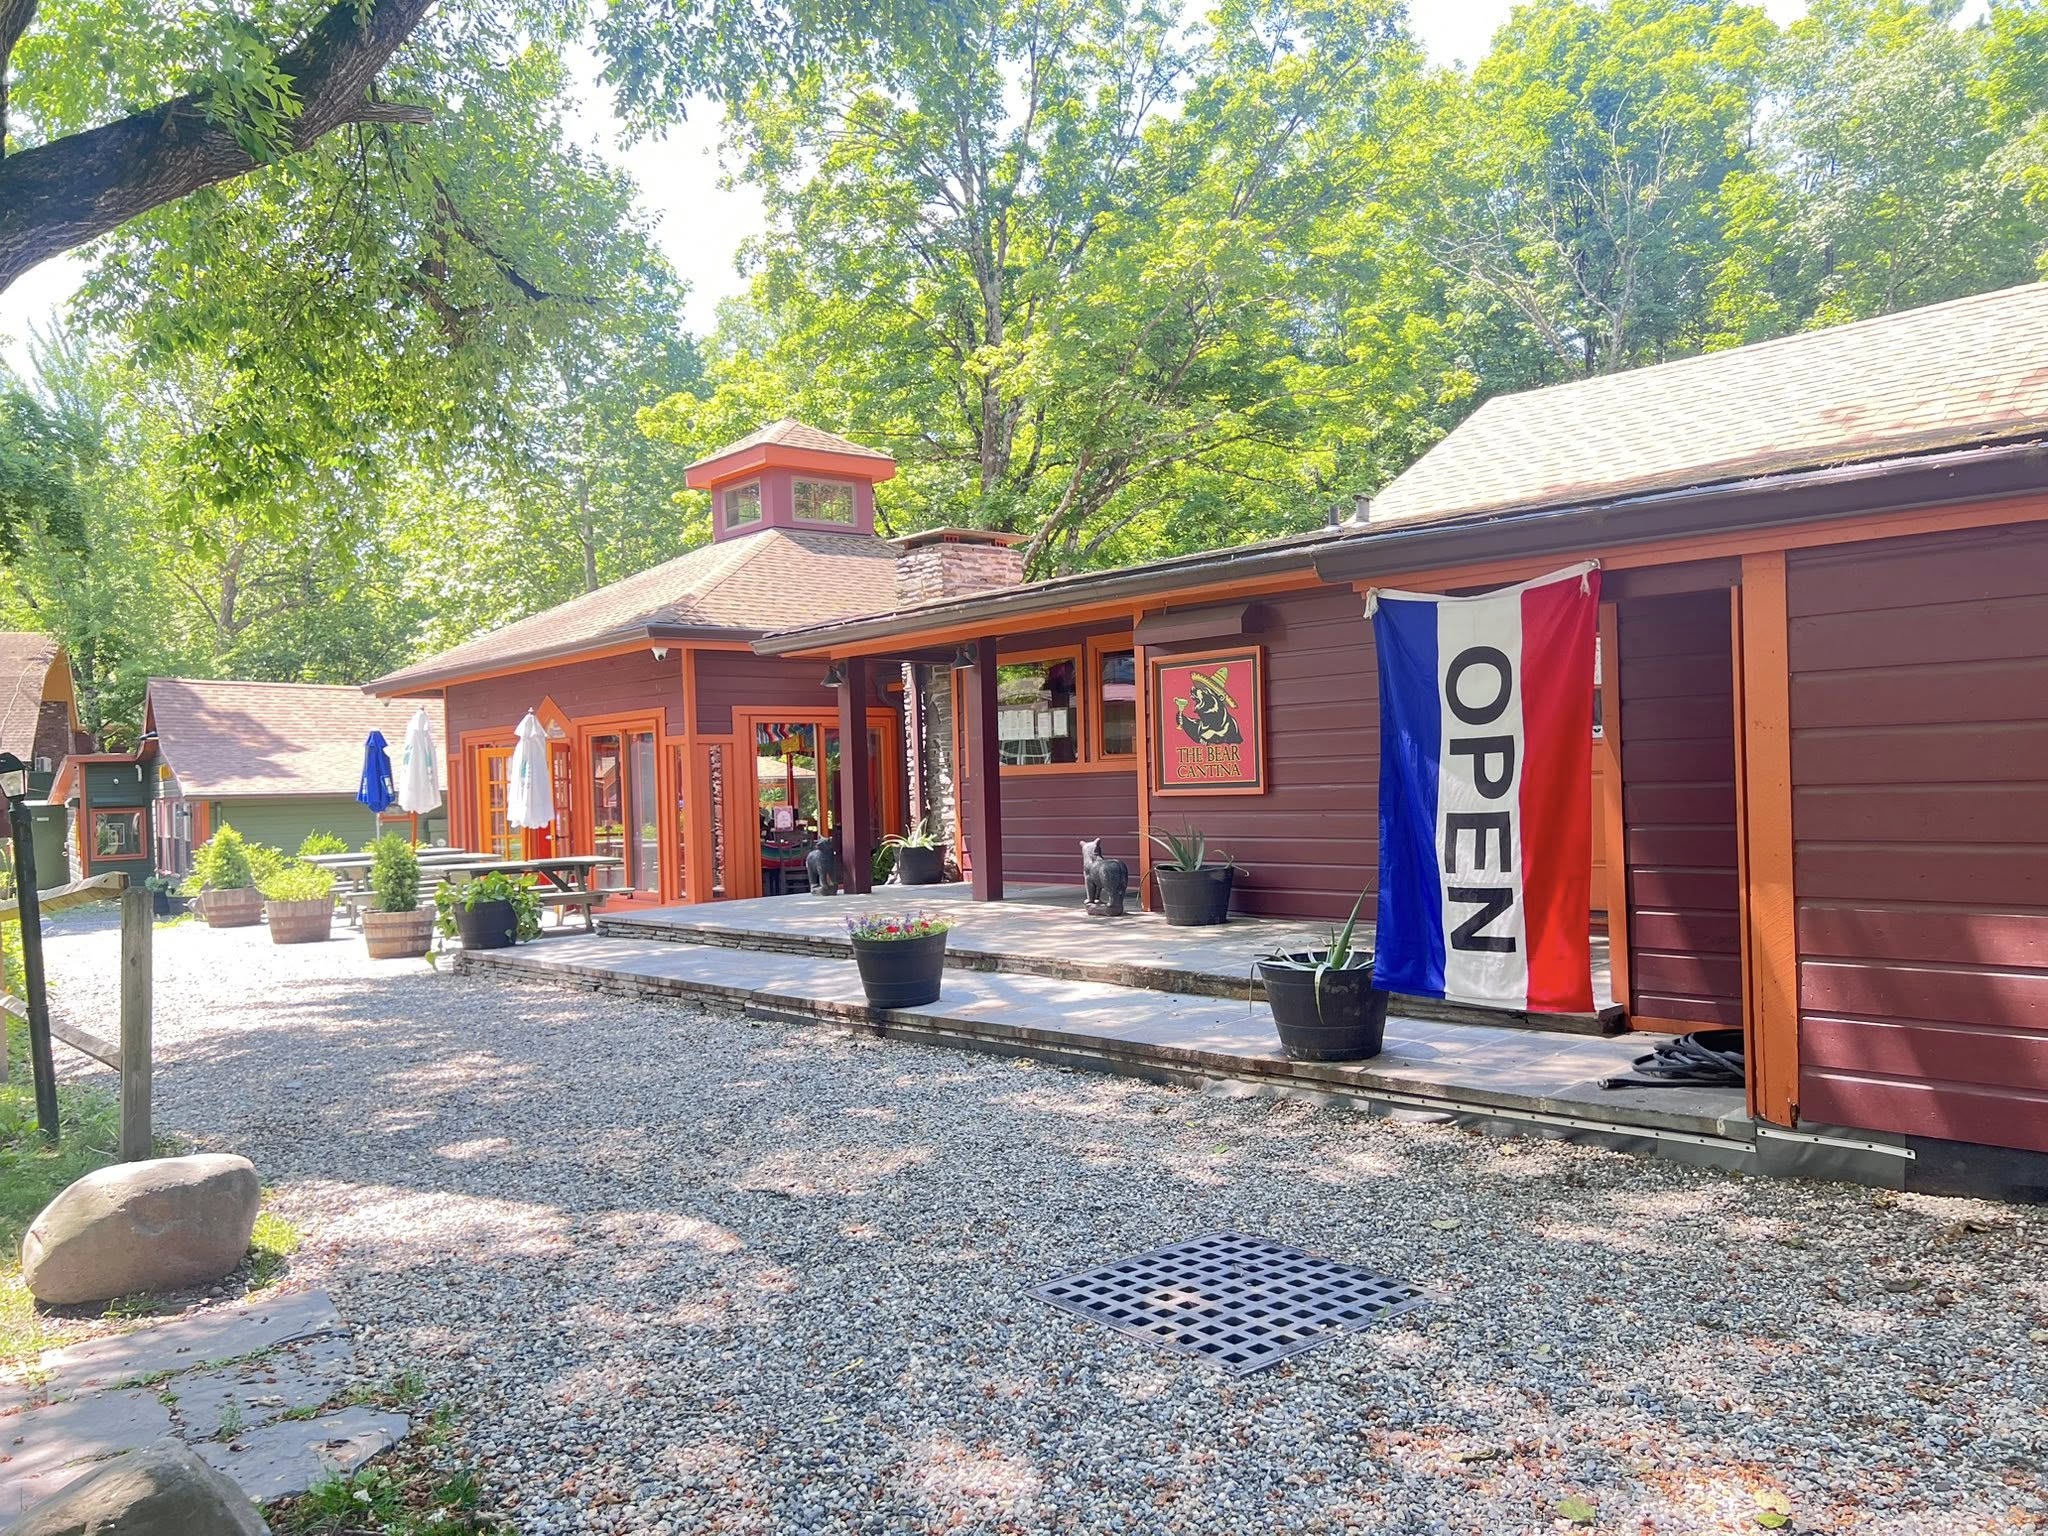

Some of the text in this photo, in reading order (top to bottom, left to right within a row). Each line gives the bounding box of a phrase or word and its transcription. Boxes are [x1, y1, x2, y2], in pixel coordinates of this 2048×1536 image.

[1177, 745, 1241, 763] THE BEAR
[1177, 763, 1241, 778] CANTINA
[1445, 645, 1516, 953] OPEN
